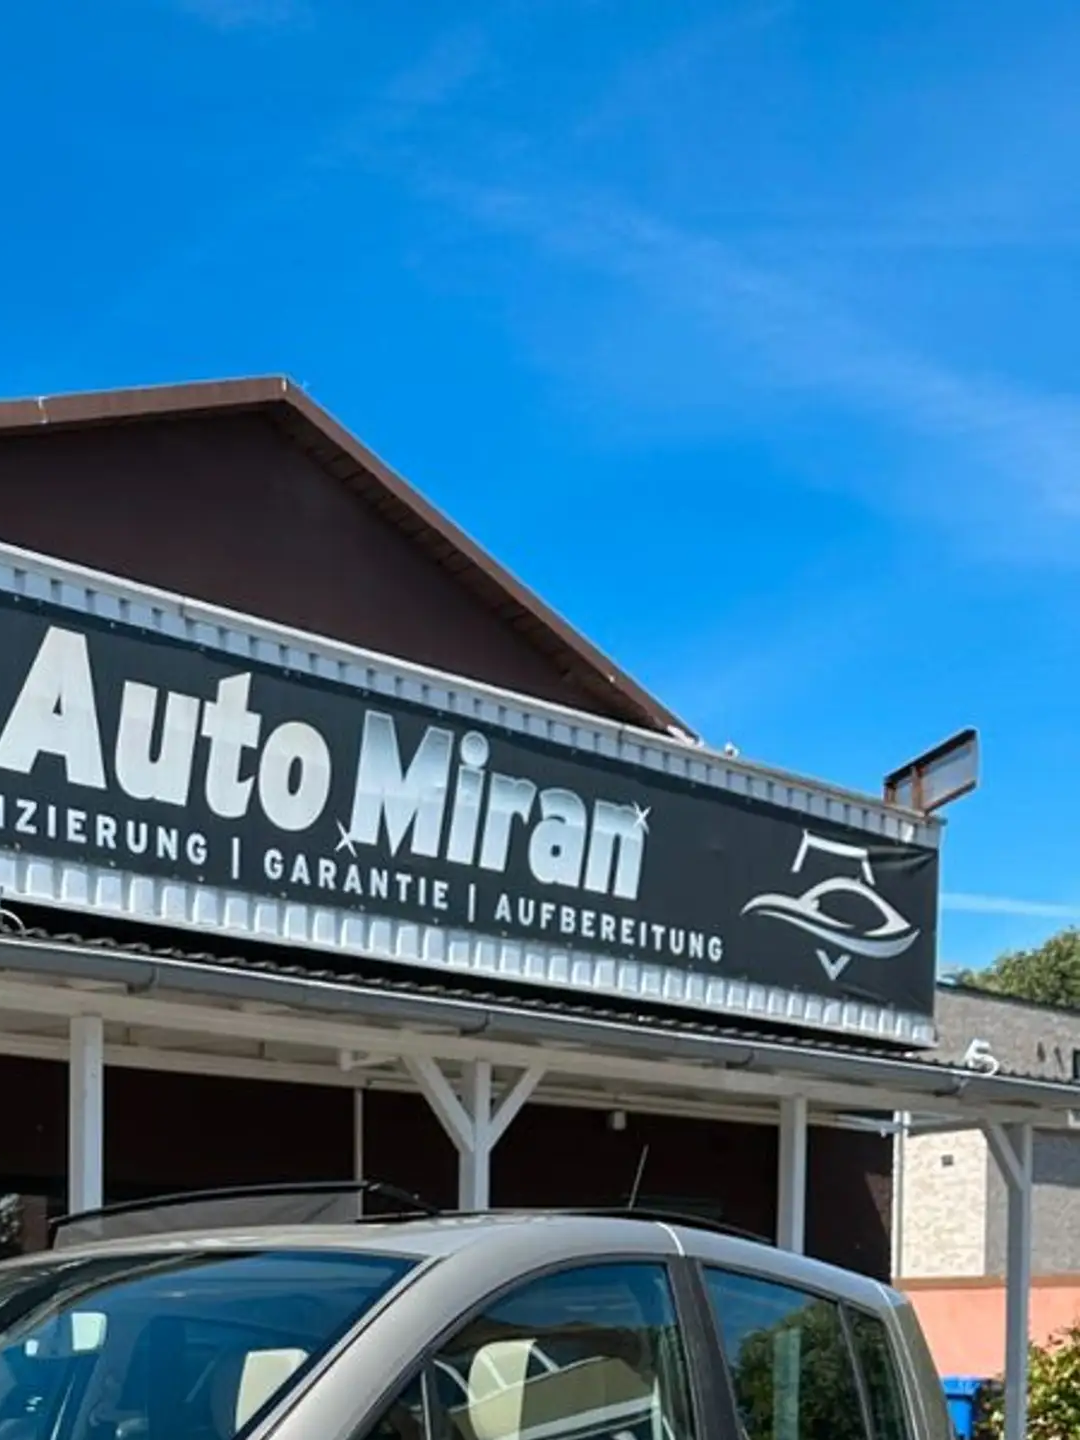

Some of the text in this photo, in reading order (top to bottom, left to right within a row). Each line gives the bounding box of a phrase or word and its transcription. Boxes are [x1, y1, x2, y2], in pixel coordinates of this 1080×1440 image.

[349, 709, 650, 900] Miran
[263, 849, 450, 911] GARANTIE
[494, 893, 724, 963] AUFBEREITUNG
